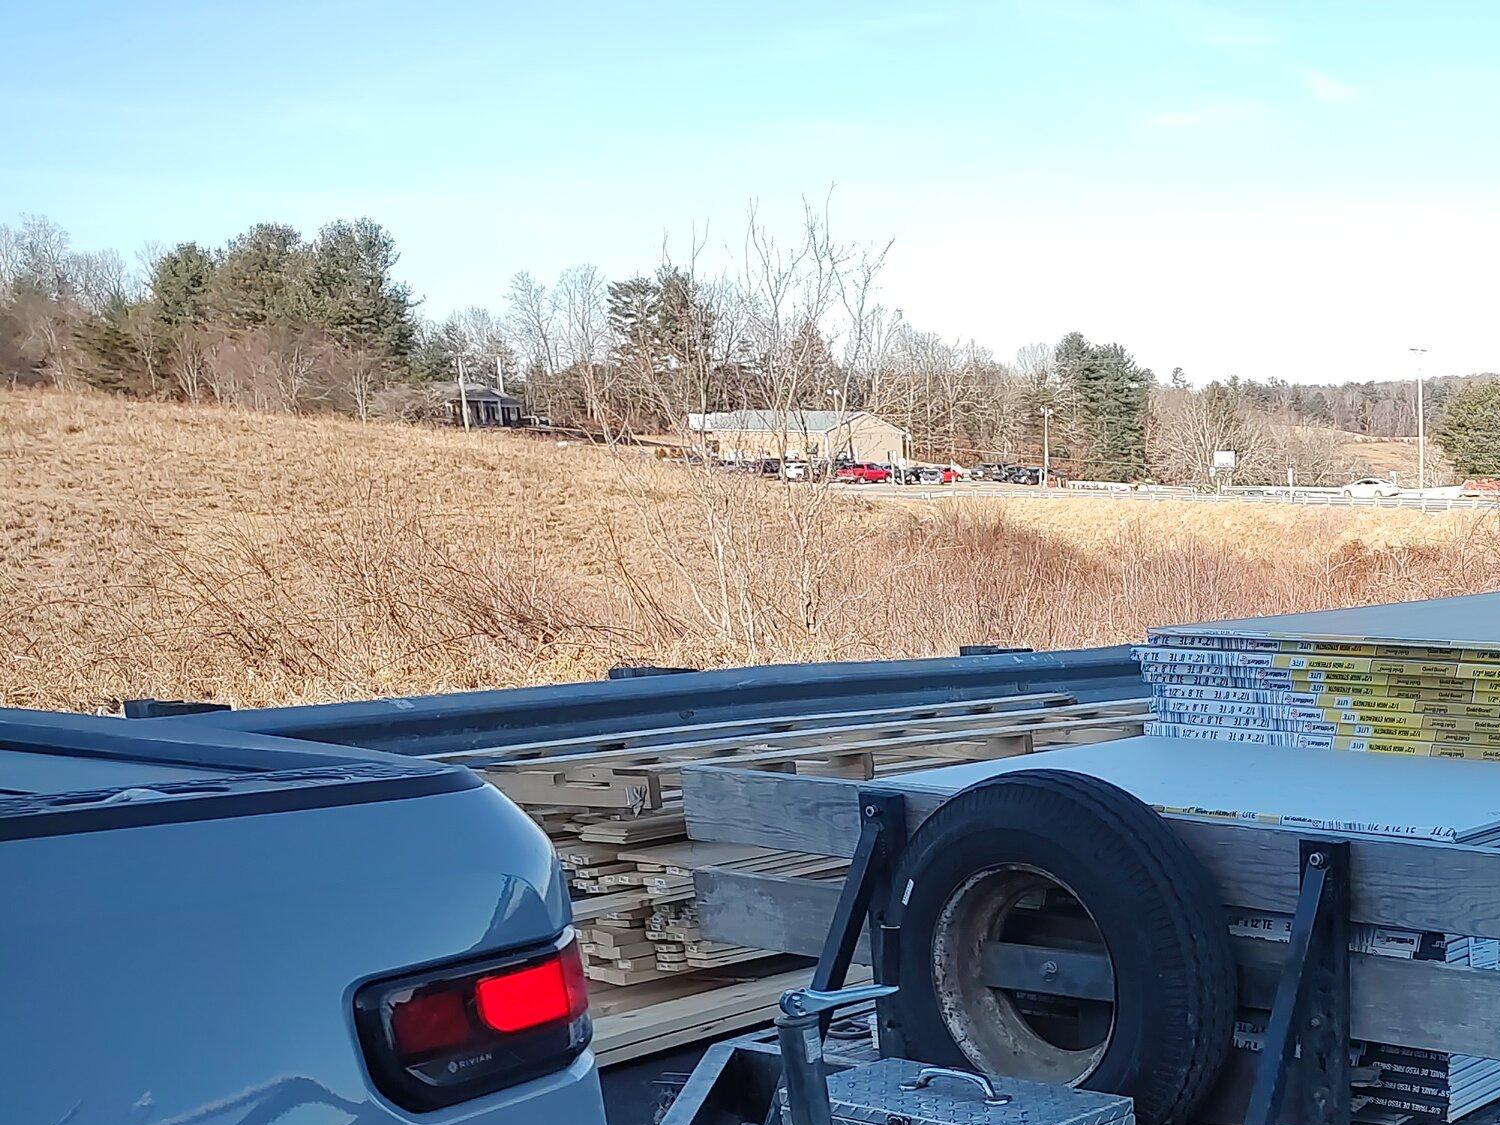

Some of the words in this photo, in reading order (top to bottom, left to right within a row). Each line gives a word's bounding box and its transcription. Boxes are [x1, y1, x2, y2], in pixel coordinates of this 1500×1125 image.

[1151, 653, 1159, 661] TE
[1176, 675, 1184, 683] TE
[1195, 690, 1204, 698] TE
[1199, 704, 1209, 712] TE
[1209, 730, 1218, 740] TE
[1263, 919, 1274, 930] TE
[459, 1053, 492, 1069] RIVIAN
[1406, 1066, 1419, 1075] YESO
[1420, 1068, 1428, 1076] DE
[1397, 1083, 1410, 1092] YESO
[1388, 1100, 1402, 1108] YESO
